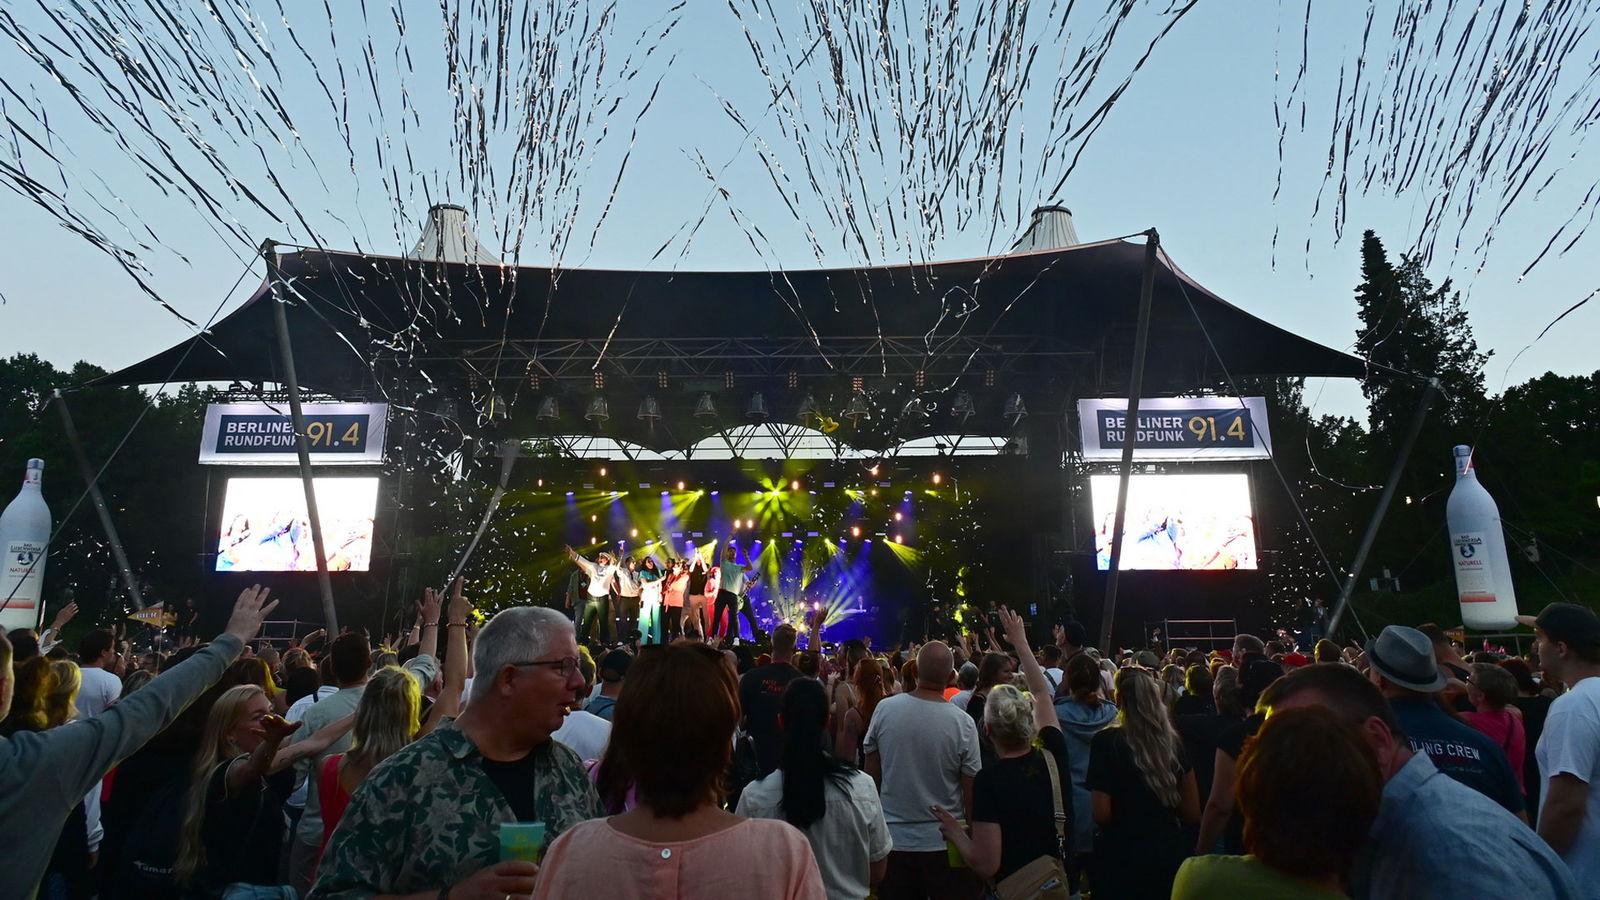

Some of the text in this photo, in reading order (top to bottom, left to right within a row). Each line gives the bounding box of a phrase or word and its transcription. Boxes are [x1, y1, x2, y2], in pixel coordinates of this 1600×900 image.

[1105, 417, 1183, 429] BELINER
[1188, 416, 1245, 441] 91.4
[306, 422, 359, 446] 91.4
[1107, 430, 1184, 442] RUDFUNK
[1446, 743, 1480, 761] CREW
